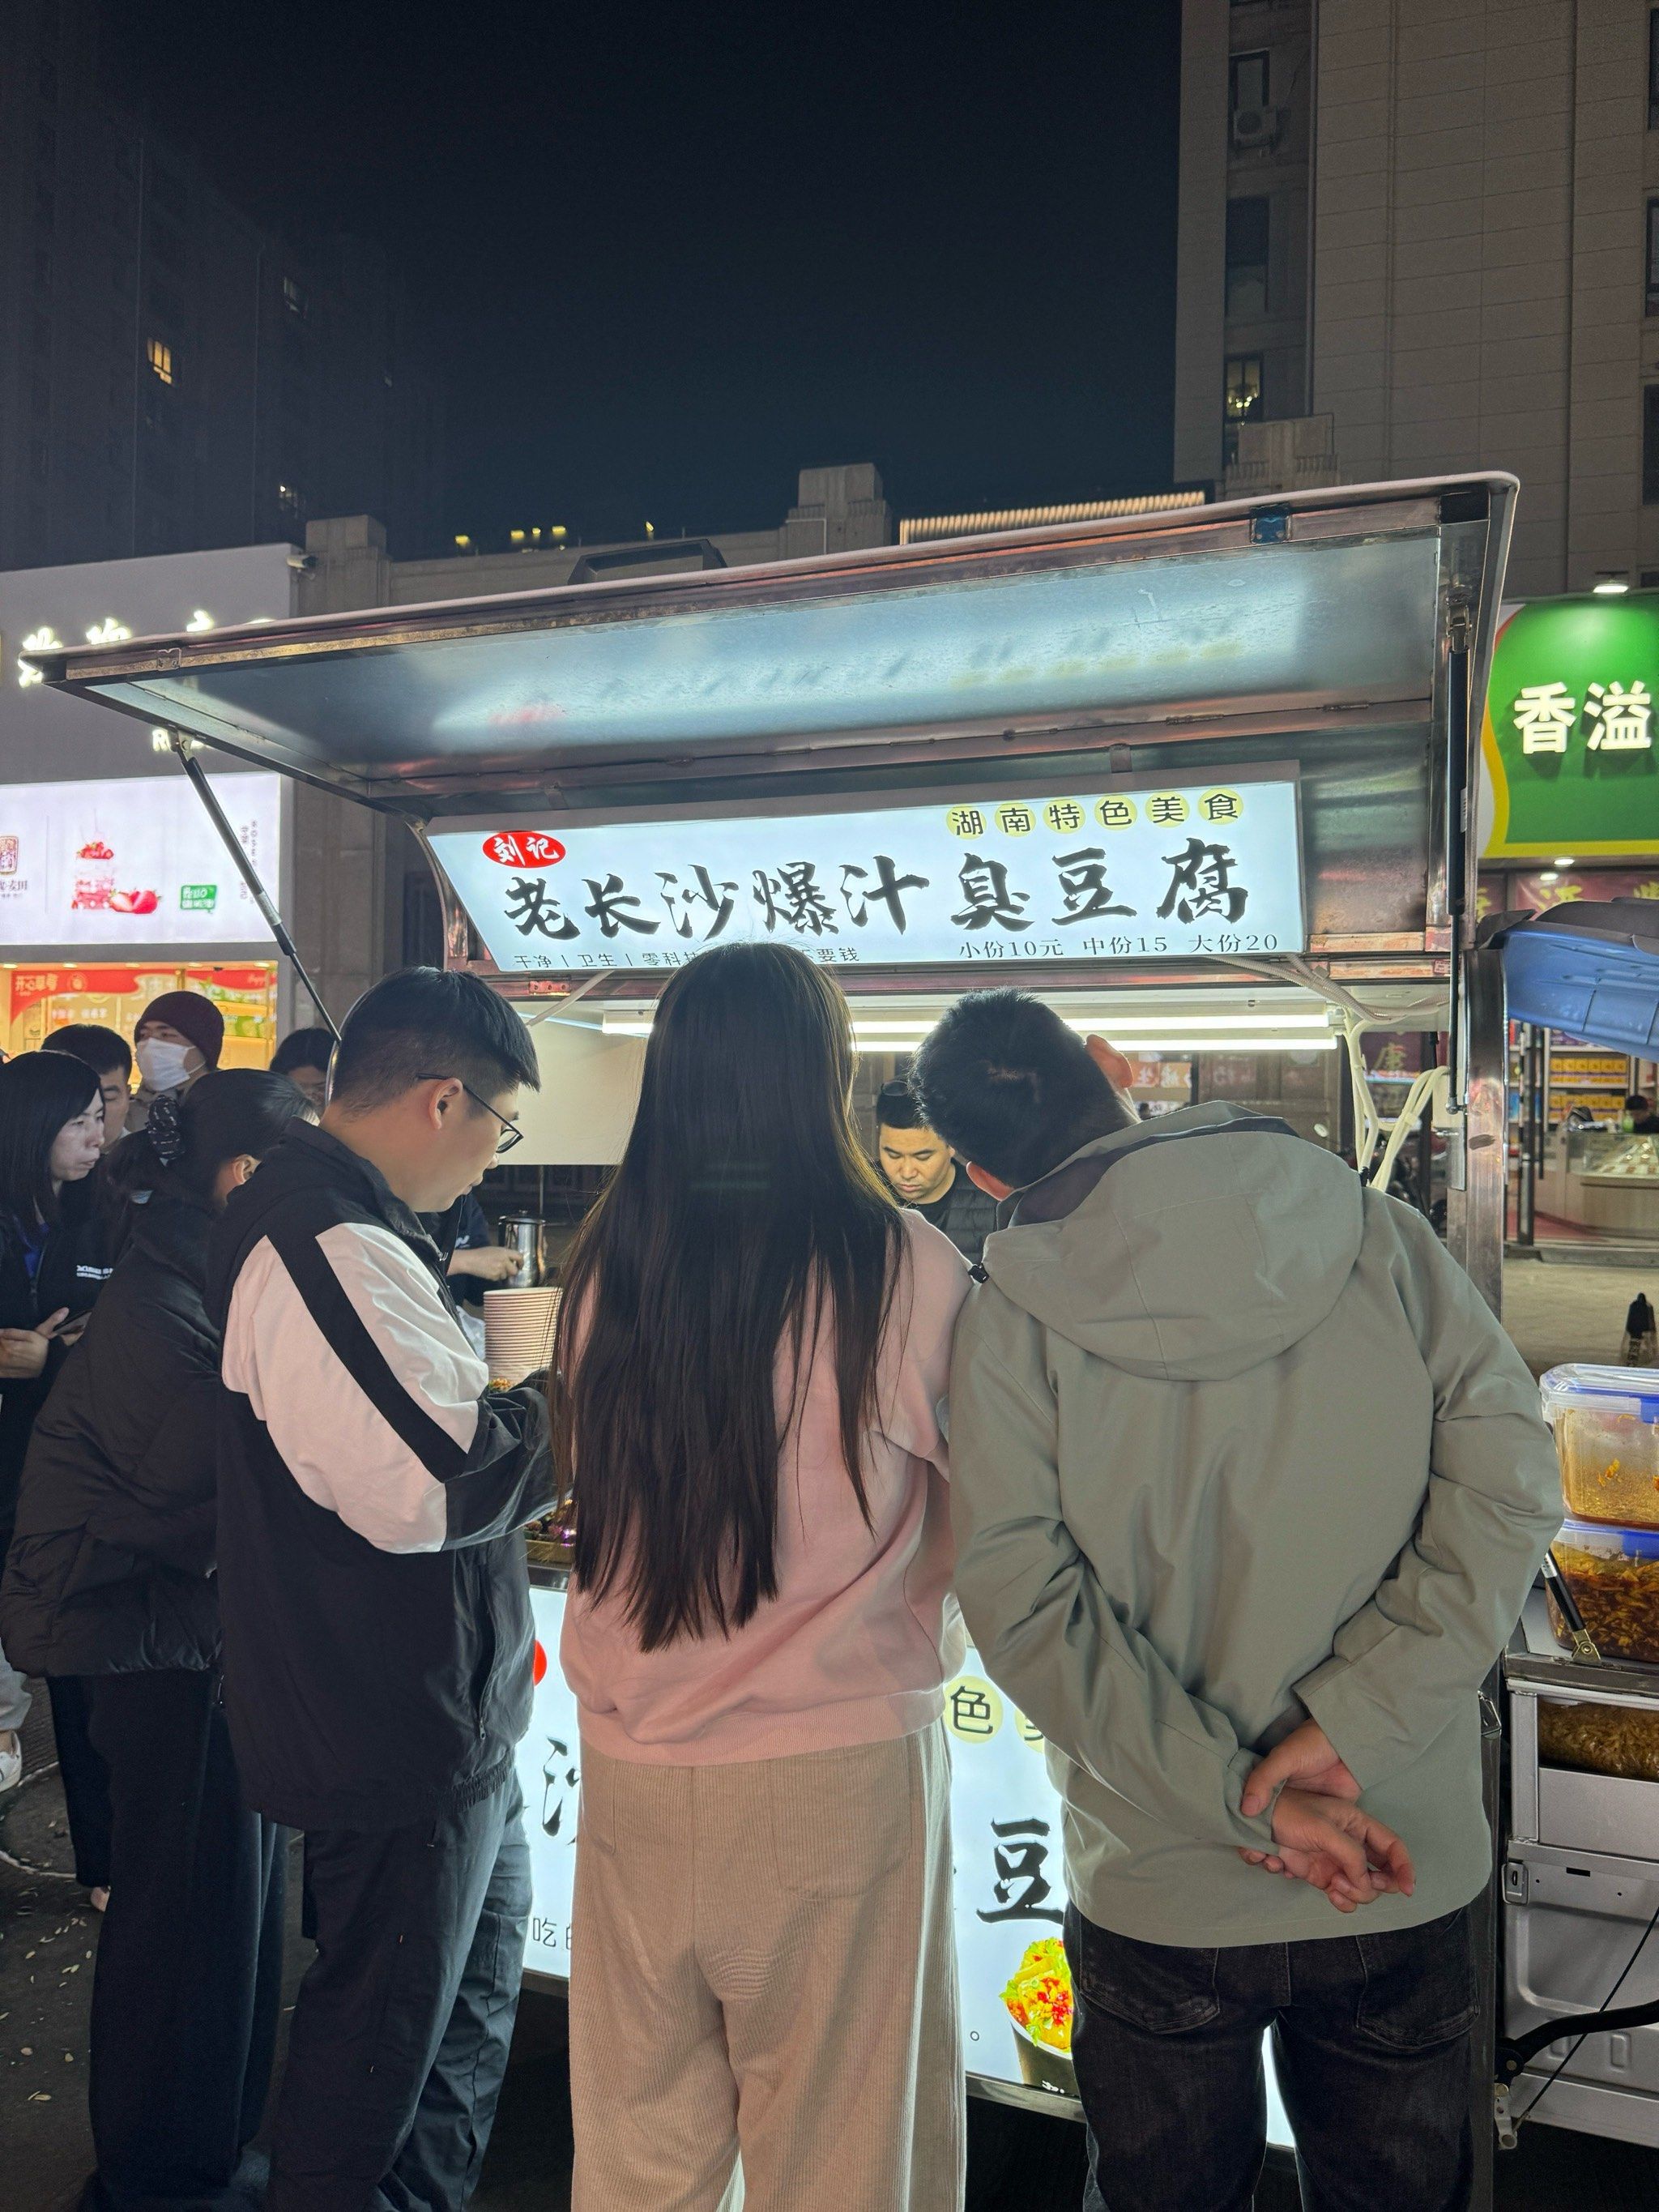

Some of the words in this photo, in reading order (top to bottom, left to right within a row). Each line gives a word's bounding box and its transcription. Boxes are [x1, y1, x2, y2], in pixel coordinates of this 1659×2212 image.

[1512, 680, 1653, 754] 香溢
[951, 792, 1239, 836] 湖南特色美食
[493, 835, 559, 865] 刘记
[503, 837, 1250, 941] 老长沙爆汁臭豆腐
[959, 938, 1064, 959] 小份10元
[1082, 936, 1169, 955] 中份15
[1188, 933, 1277, 952] 大份20
[976, 1817, 1064, 1926] 豆
